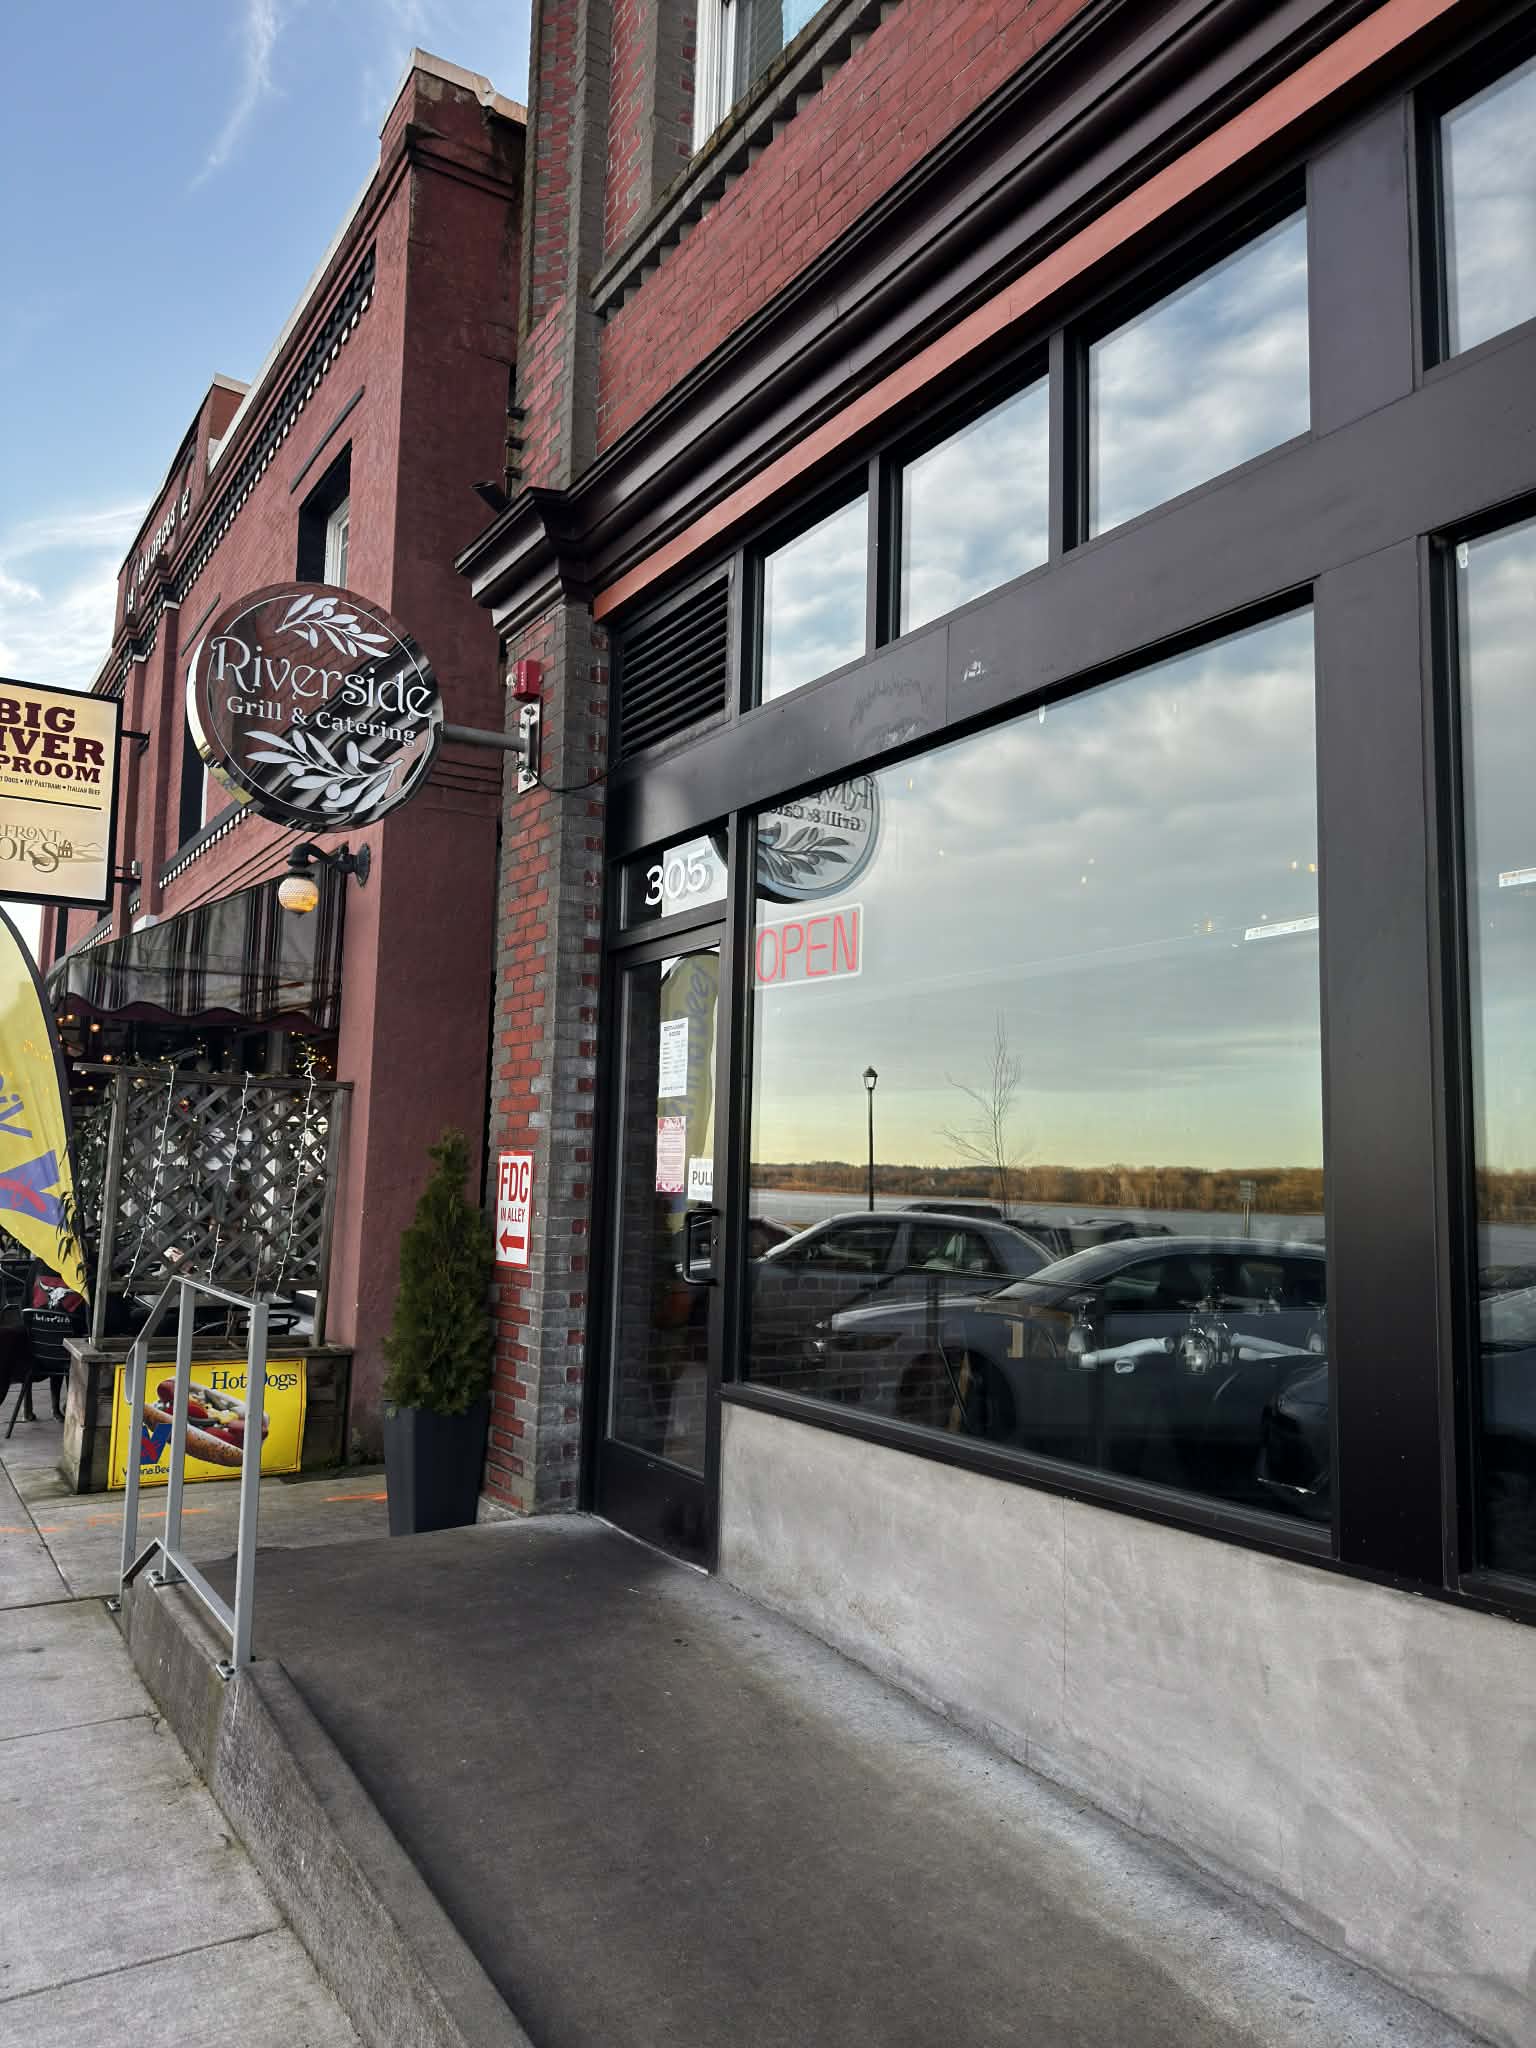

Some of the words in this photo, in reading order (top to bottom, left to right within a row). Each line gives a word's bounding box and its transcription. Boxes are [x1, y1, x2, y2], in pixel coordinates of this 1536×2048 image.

[210, 636, 433, 721] Riverside
[0, 697, 76, 733] BIG
[226, 696, 282, 721] Grill
[291, 707, 309, 726] &
[316, 711, 417, 748] Catering
[645, 846, 709, 906] 305
[755, 911, 859, 983] OPEN
[500, 1161, 529, 1203] FDC
[692, 1170, 714, 1186] PULL
[500, 1207, 507, 1222] IN
[507, 1207, 526, 1223] ALLEY
[210, 1370, 248, 1390] Hot
[264, 1371, 298, 1391] ogs
